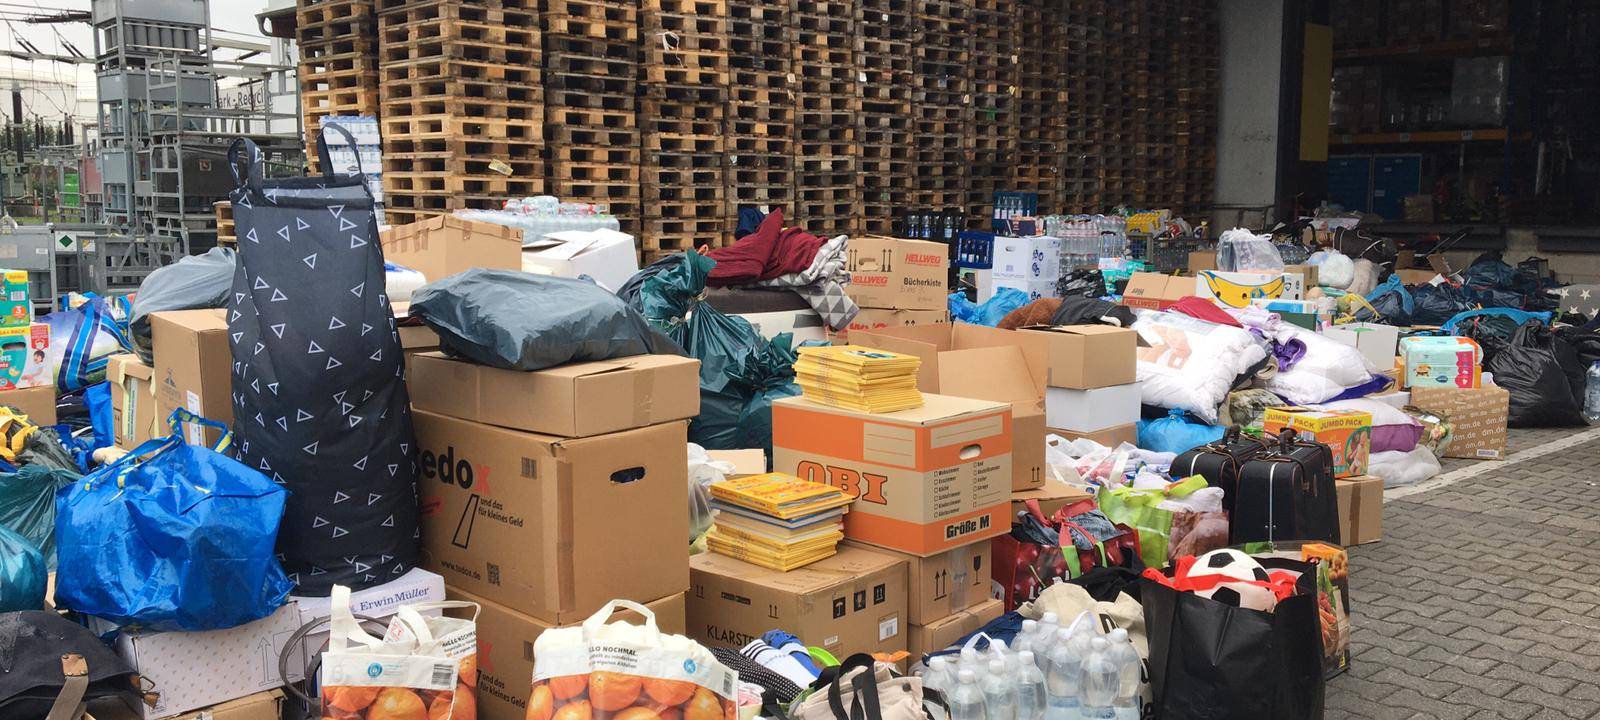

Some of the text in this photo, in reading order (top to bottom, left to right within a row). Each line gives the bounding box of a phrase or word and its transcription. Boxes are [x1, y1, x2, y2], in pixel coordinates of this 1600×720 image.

[905, 253, 941, 264] HELLWEG
[903, 277, 941, 287] Bücherkiste
[1320, 418, 1362, 429] JUMBO PACK
[1460, 420, 1481, 430] dm.de
[1453, 426, 1505, 441] dm.de dm.de
[797, 460, 888, 505] OBI
[480, 498, 503, 510] und das
[479, 506, 523, 527] für kleines Geld
[946, 514, 990, 538] Größe M
[360, 587, 430, 611] Erwin Müller
[482, 674, 505, 689] und das
[480, 682, 526, 708] für kleines Geld
